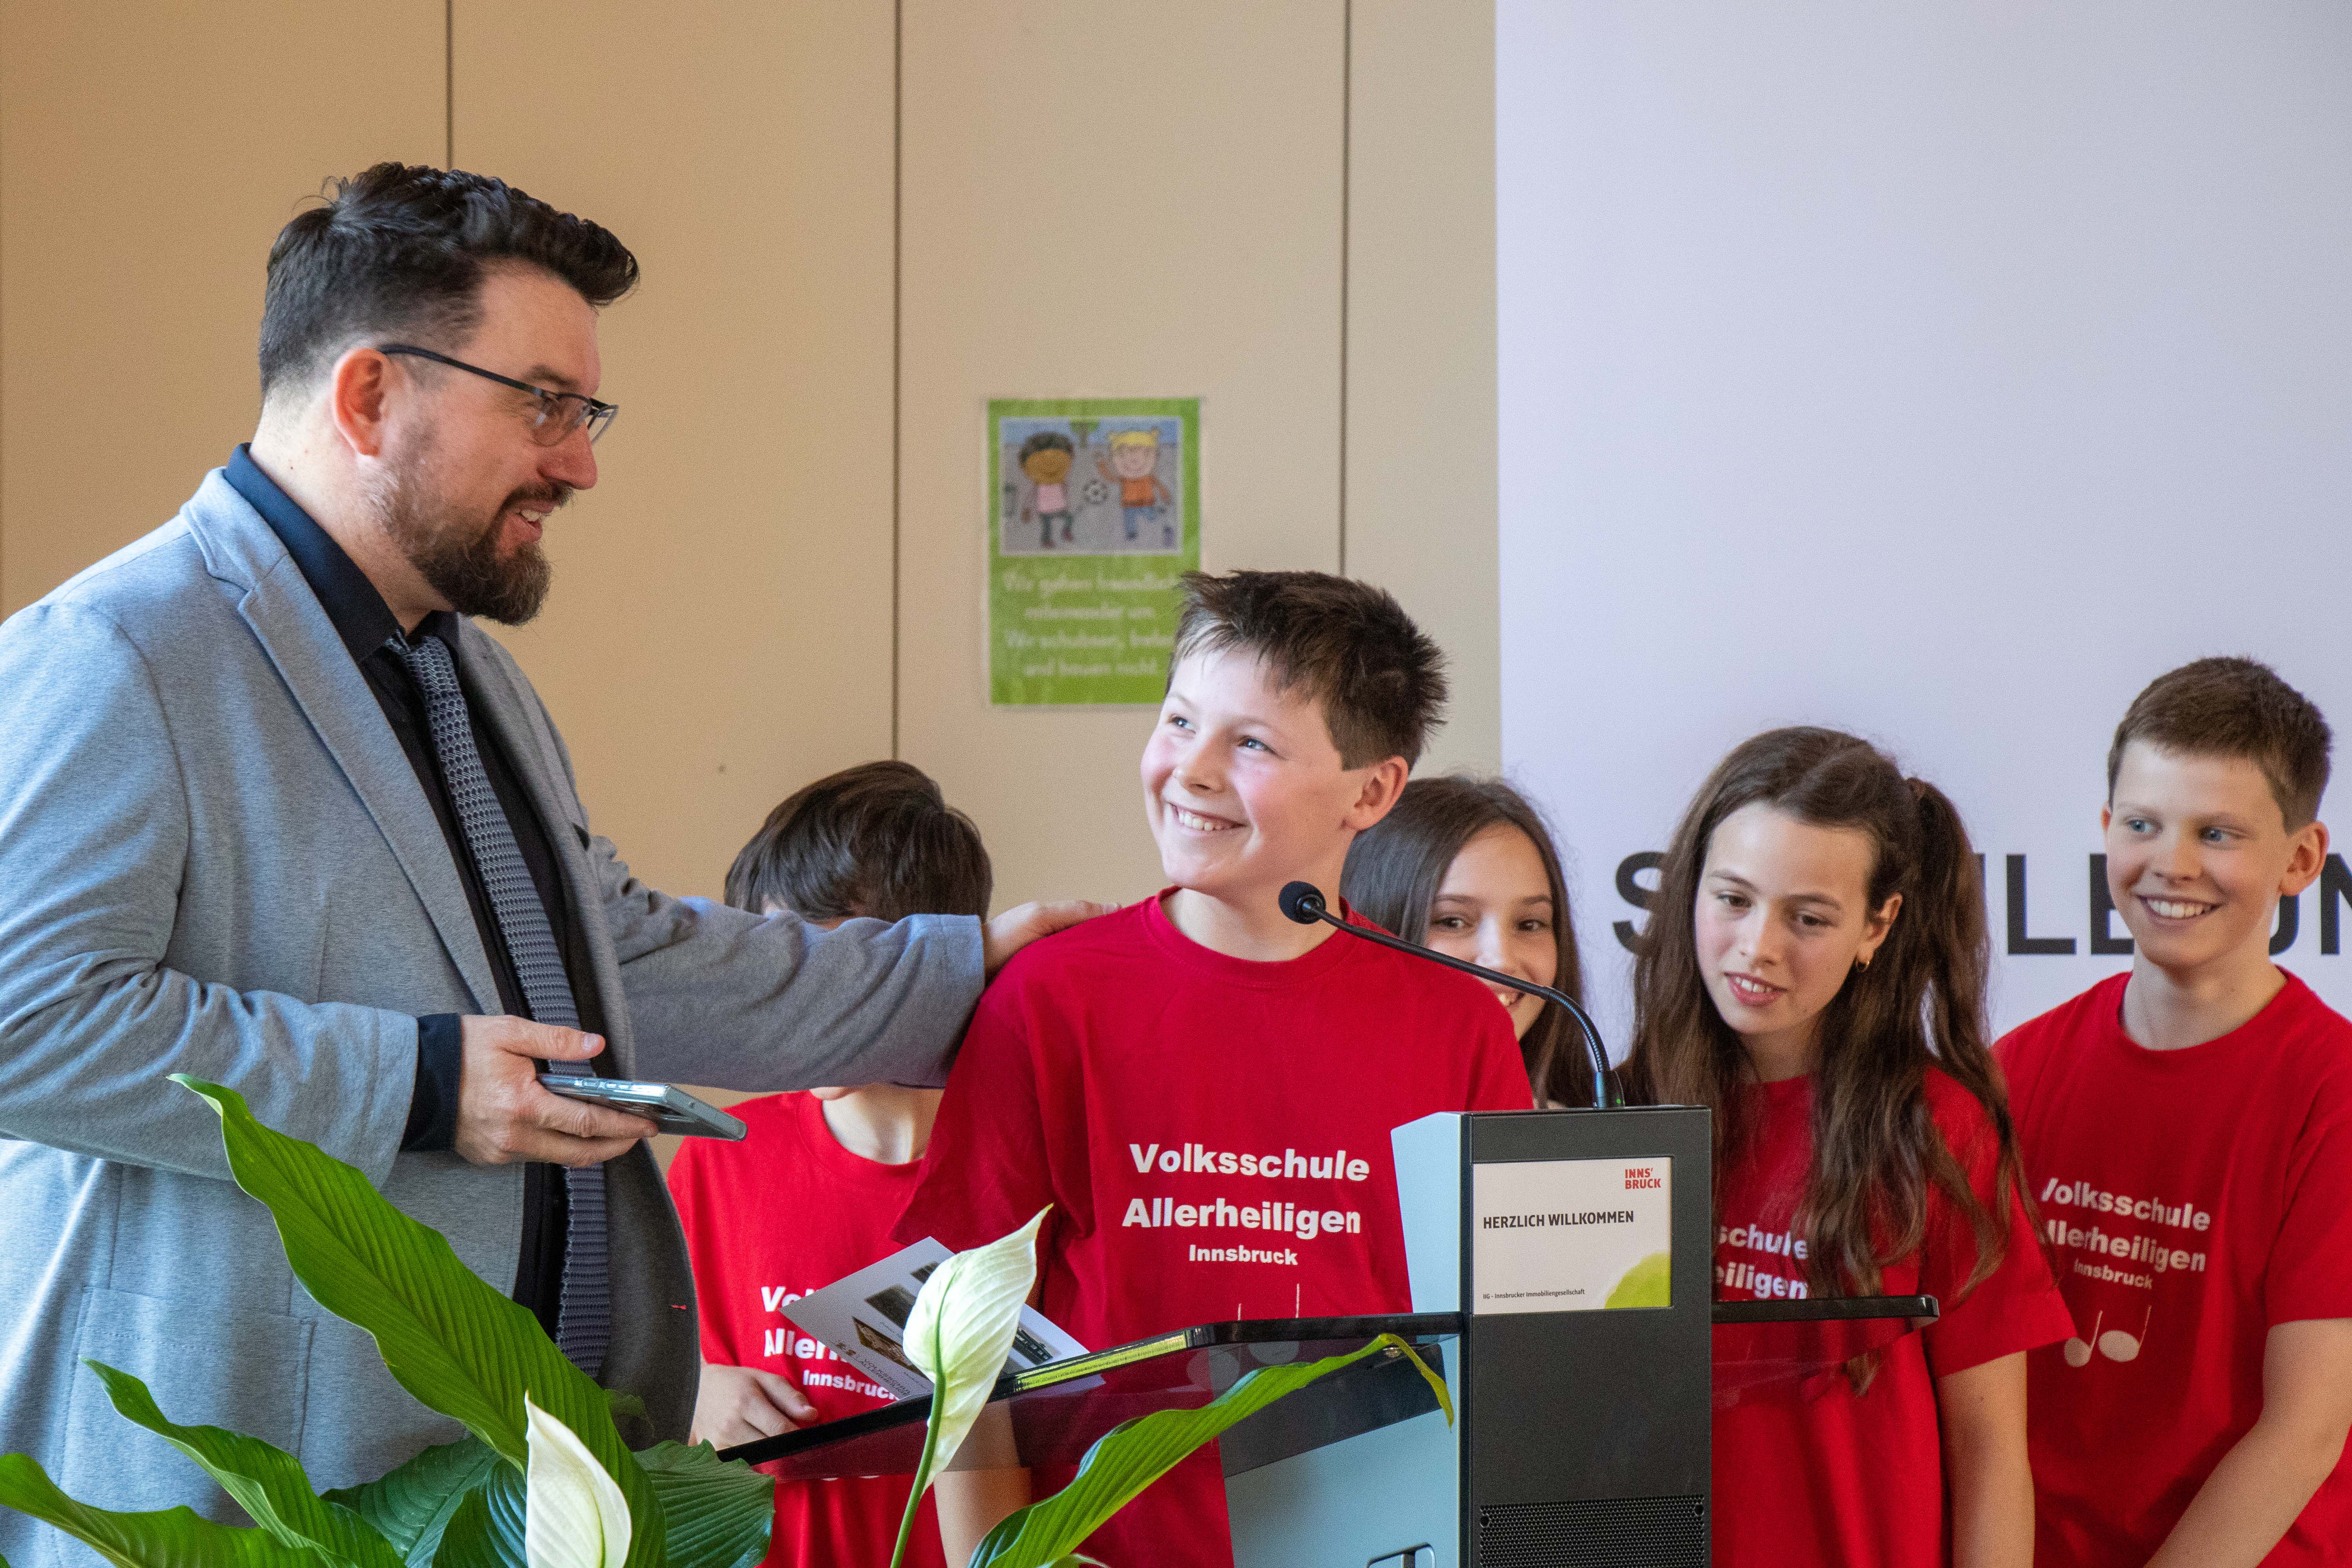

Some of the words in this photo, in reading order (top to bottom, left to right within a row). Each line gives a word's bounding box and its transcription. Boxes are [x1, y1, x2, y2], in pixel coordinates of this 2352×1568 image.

[1129, 1143, 1369, 1181] Volksschule
[1625, 1178, 1661, 1189] BRUCK
[1122, 1197, 1360, 1240] Allerheiligen
[1483, 1215, 1544, 1229] HERZLICH
[1548, 1210, 1633, 1226] WILLKOMMEN
[1189, 1245, 1298, 1265] Innsbruck
[2047, 1219, 2206, 1273] llerheiligen
[1526, 1288, 1584, 1298] Immobiliengesellschaft
